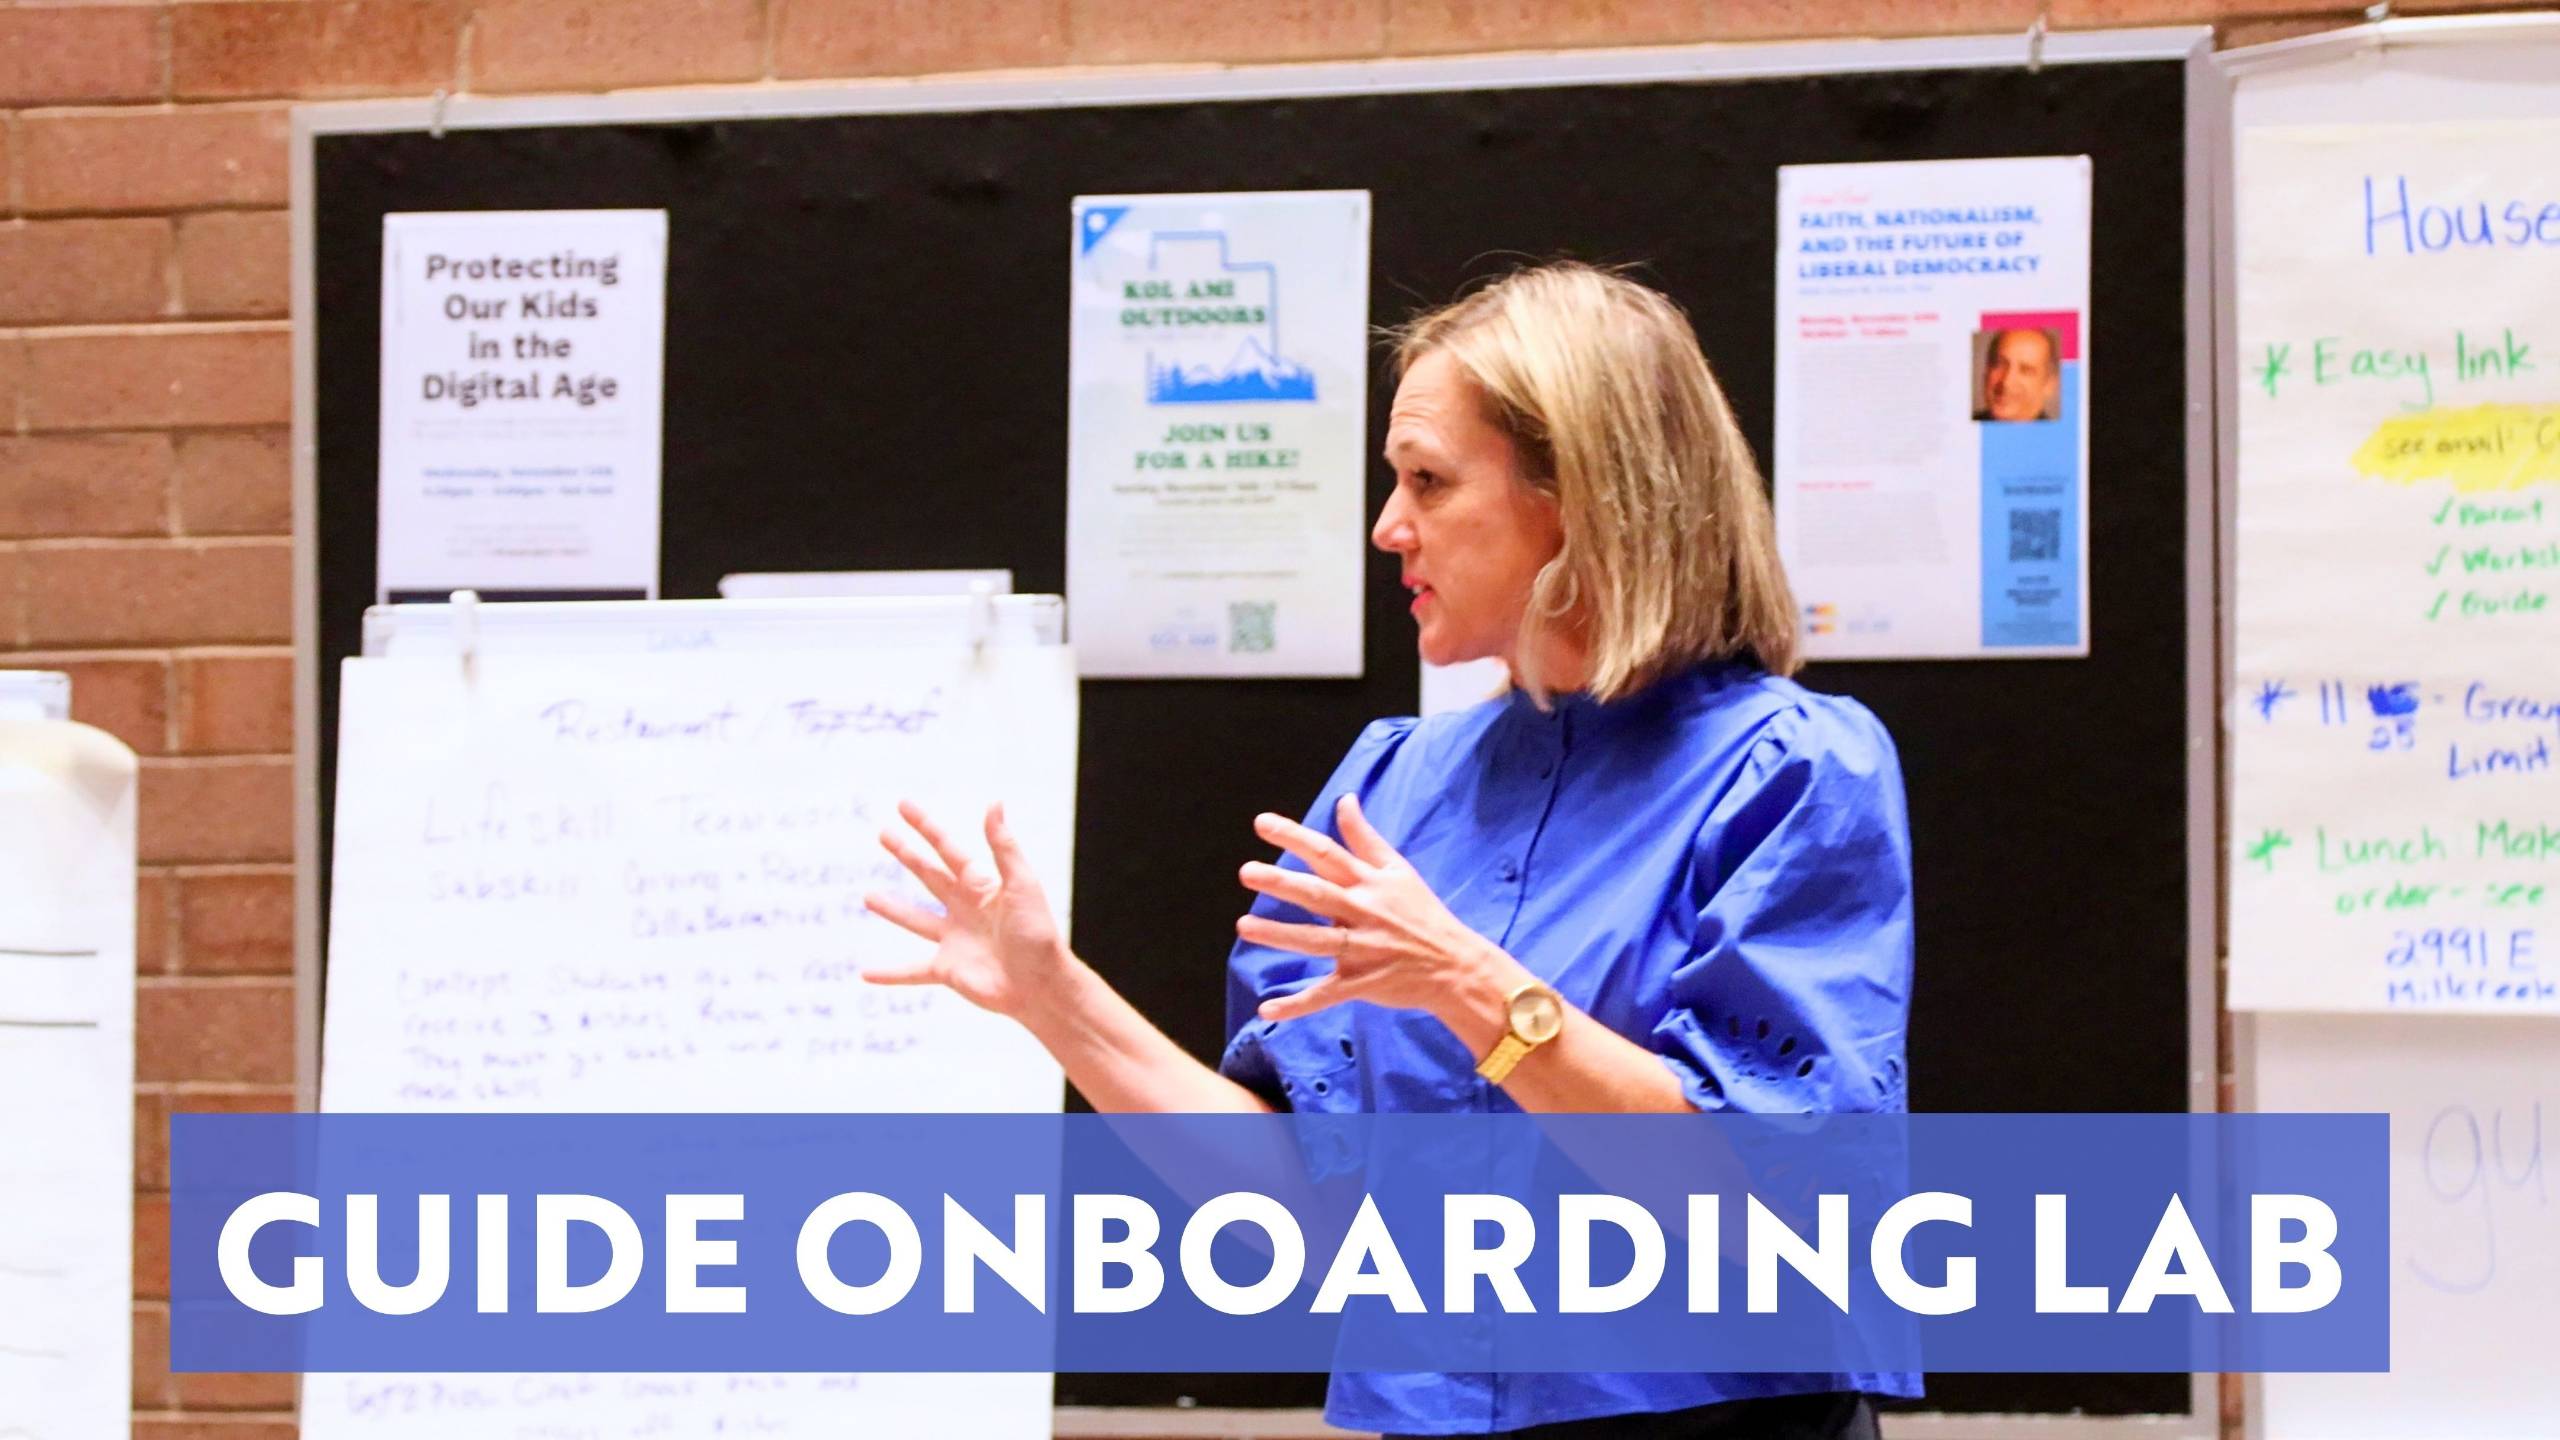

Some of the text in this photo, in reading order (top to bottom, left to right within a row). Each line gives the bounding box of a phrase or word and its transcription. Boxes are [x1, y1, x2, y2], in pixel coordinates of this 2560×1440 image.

[1799, 205, 2041, 231] FAITH, NATIONALISM,
[1799, 231, 2025, 255] AND THE FUTURE OF
[425, 251, 620, 287] Protecting
[1799, 255, 2040, 280] LIBERAL DEMOCRACY
[1123, 279, 1236, 301] KOL AMI
[443, 291, 599, 322] Our Kids
[1119, 306, 1267, 327] OUTDOORS
[468, 330, 572, 360] in the
[2313, 328, 2534, 412] Easy link
[422, 371, 619, 408] Digital Age
[1162, 423, 1273, 444] JOIN US
[1134, 449, 1299, 471] FOR A HIKE!
[2315, 823, 2448, 872] Lunch
[2385, 926, 2538, 972] 2991 E
